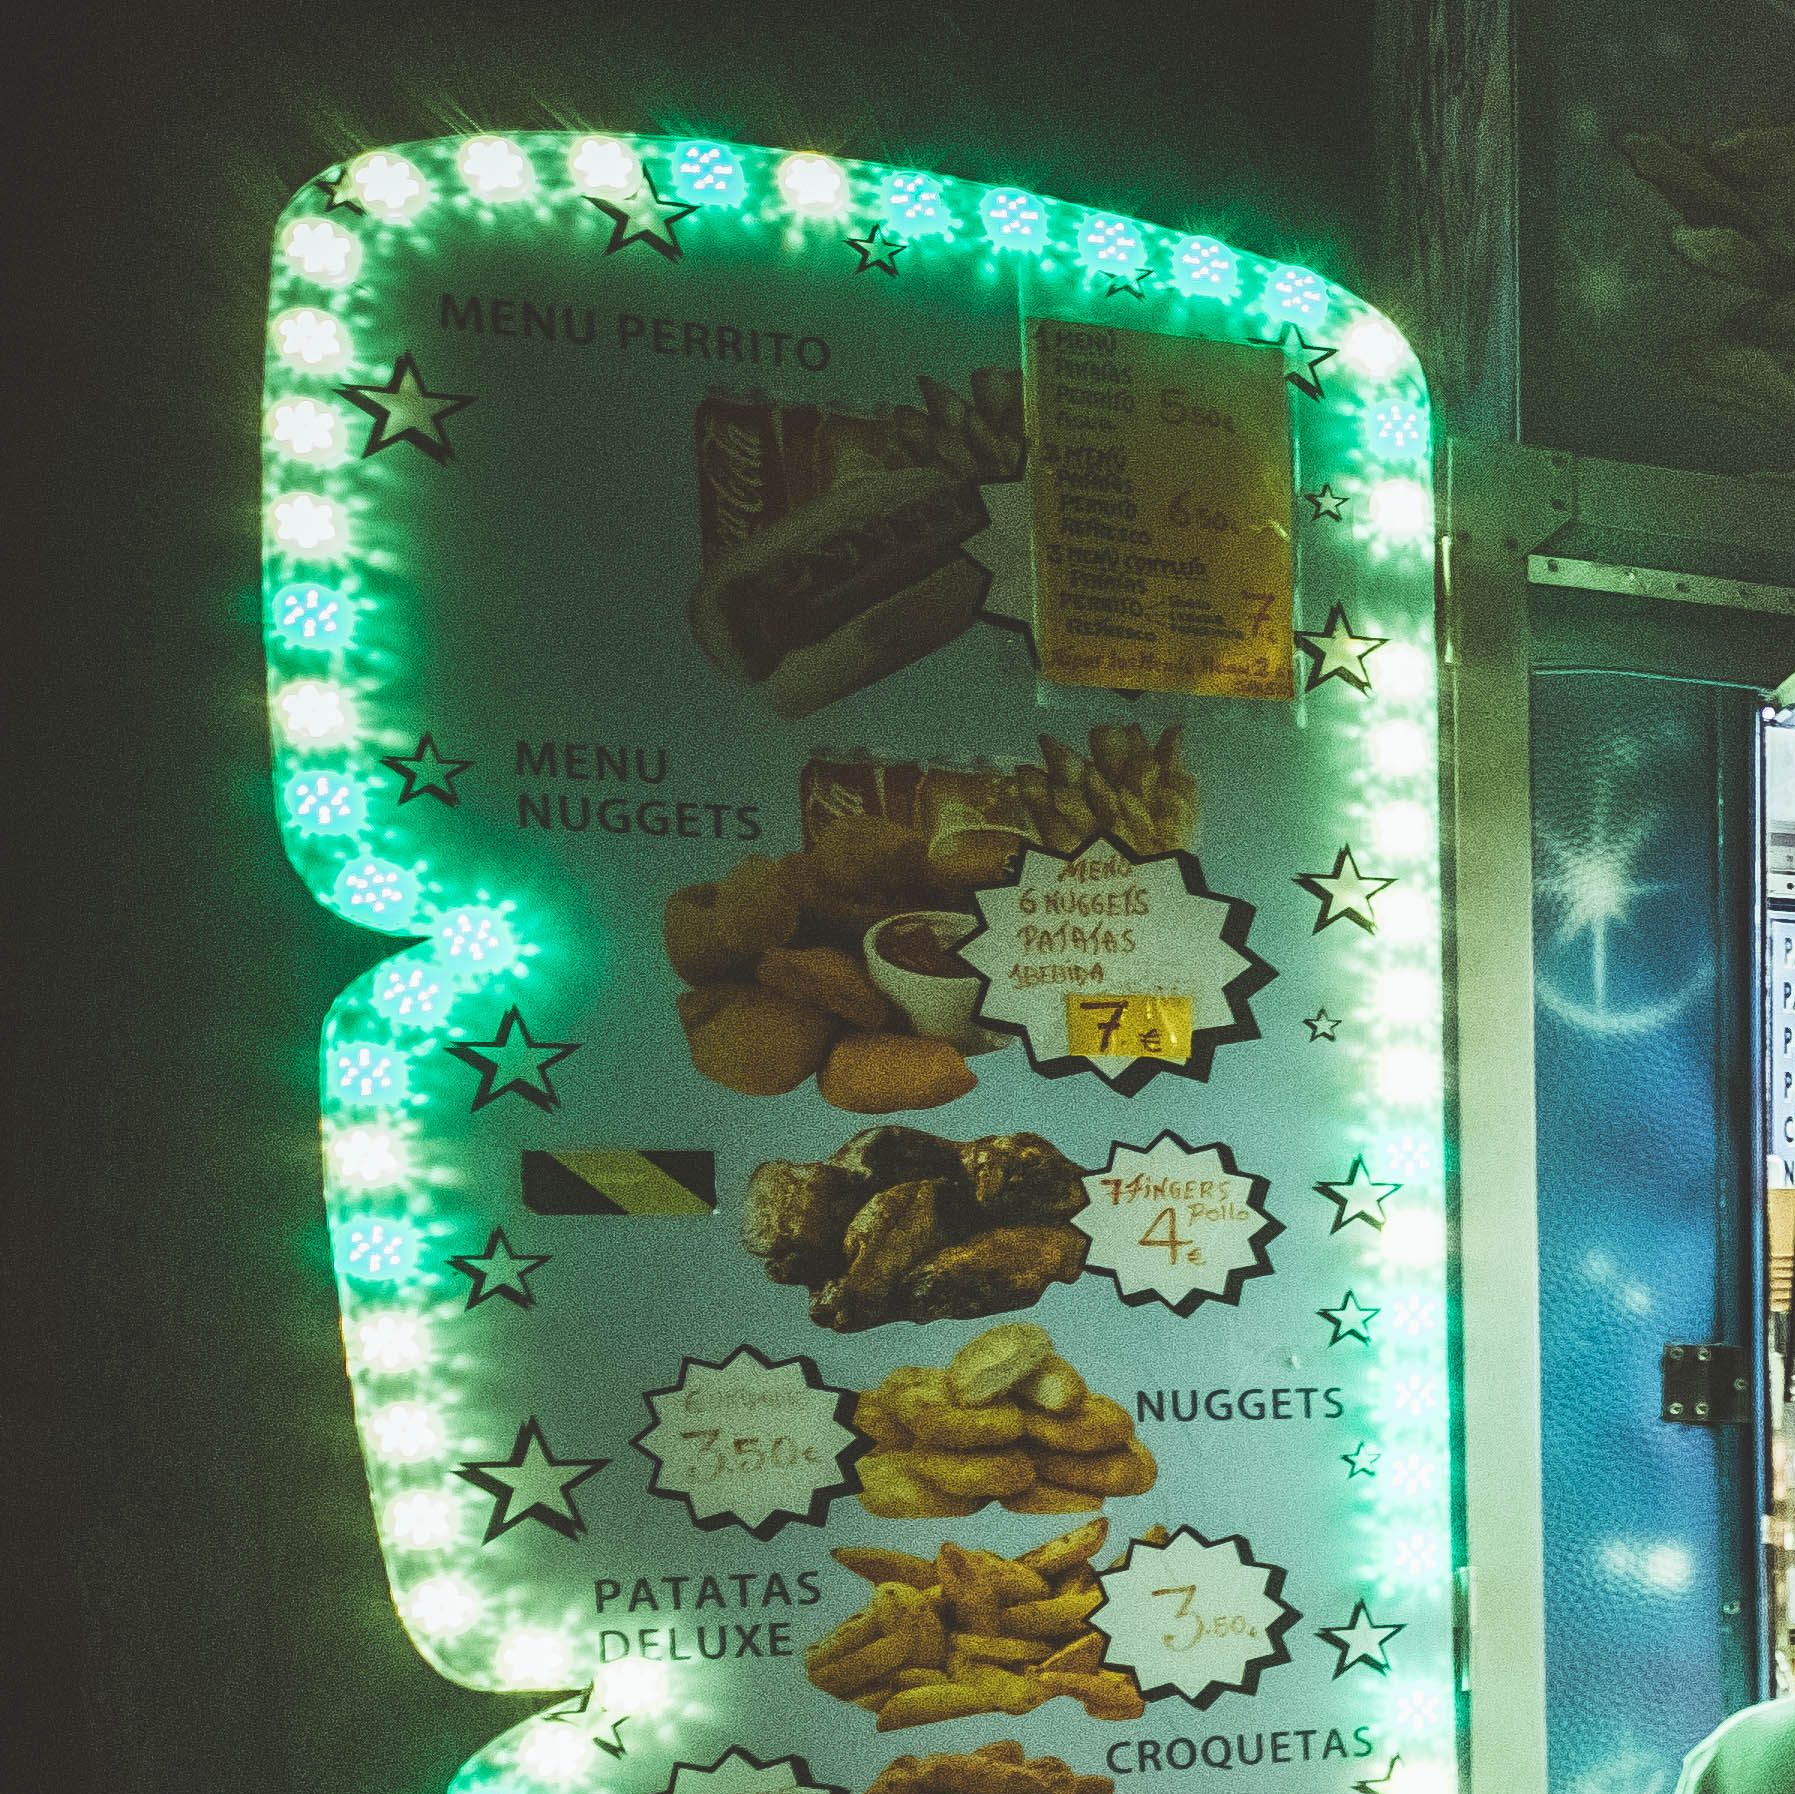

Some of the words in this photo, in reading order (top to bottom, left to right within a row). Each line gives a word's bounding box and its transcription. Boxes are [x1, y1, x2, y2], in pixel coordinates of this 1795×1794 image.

[440, 295, 600, 342] MENU
[618, 310, 832, 371] PERRITO
[516, 739, 669, 785] MENU
[518, 794, 762, 842] NUGGETS
[1134, 1384, 1346, 1423] NUGGETS
[594, 1568, 822, 1614] PATATAS
[597, 1617, 794, 1665] DELUXE
[1105, 1724, 1375, 1776] CROQUETAS
